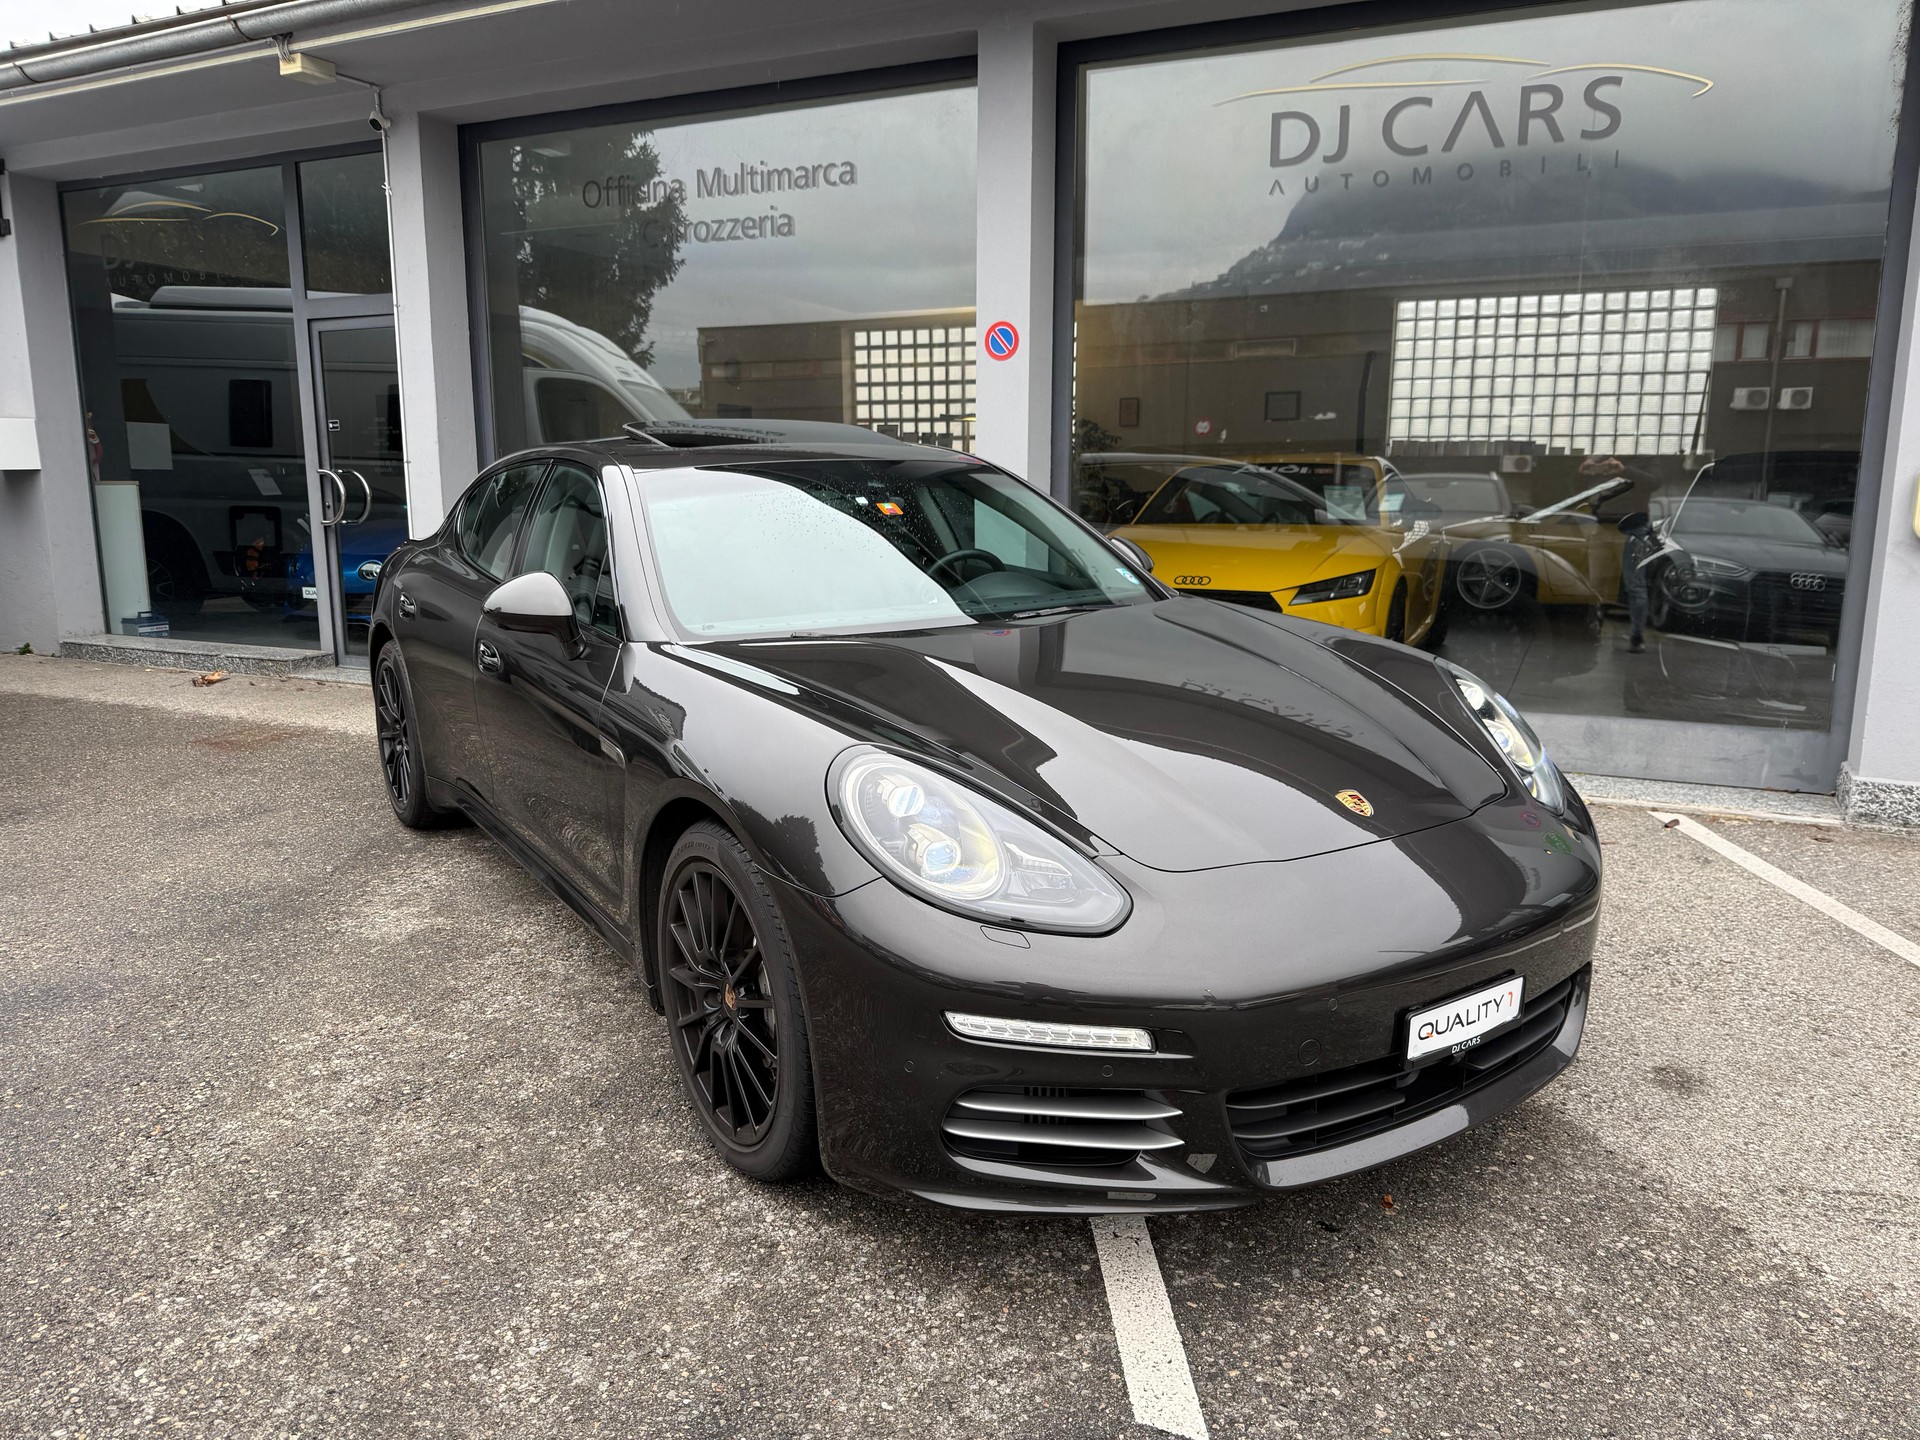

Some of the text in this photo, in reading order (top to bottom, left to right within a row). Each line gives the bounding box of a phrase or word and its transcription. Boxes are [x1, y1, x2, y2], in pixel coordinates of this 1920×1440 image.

[1269, 76, 1624, 168] DJ CARS
[582, 160, 857, 208] Officina Multimarca
[1268, 149, 1621, 197] AUTOMOBILI
[641, 204, 795, 249] Crrozzeria
[1451, 1035, 1481, 1054] DJ CARS
